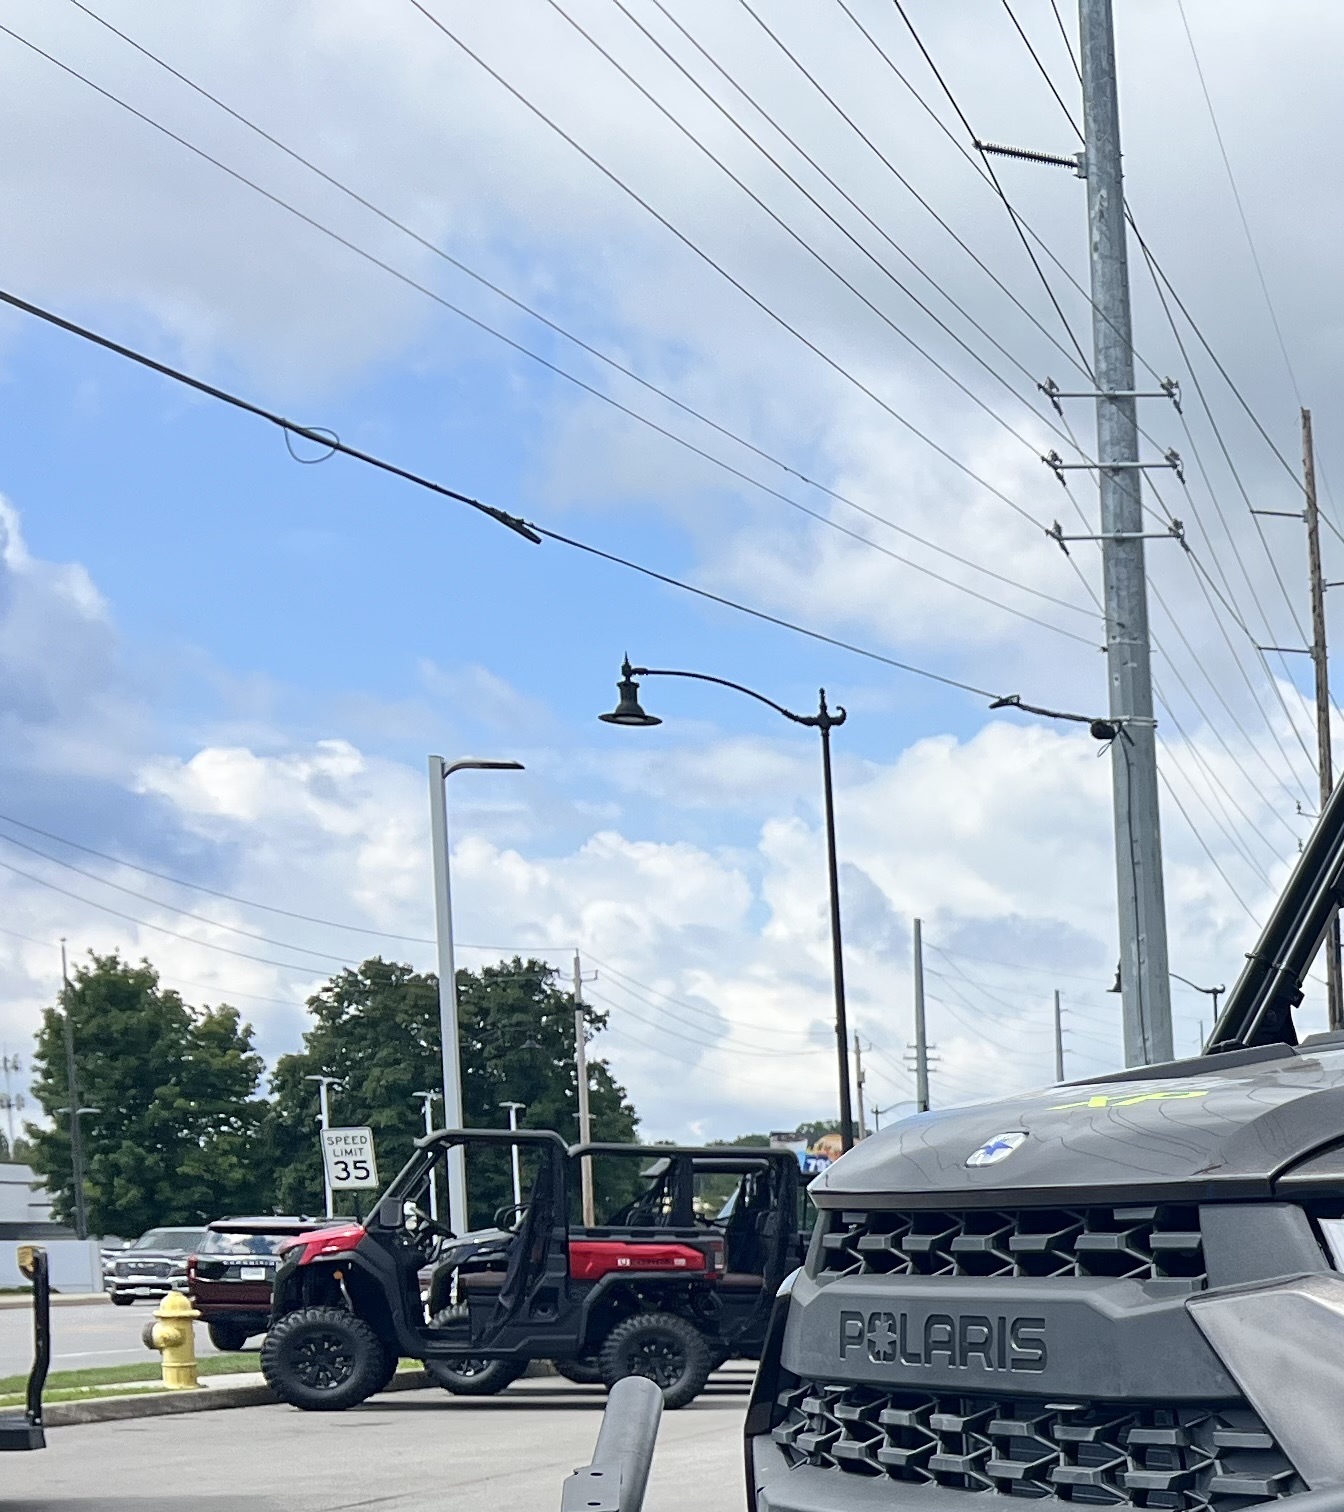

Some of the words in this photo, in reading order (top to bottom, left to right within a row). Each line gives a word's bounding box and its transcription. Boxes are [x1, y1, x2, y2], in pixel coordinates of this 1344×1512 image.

[326, 1135, 368, 1146] SPEED
[332, 1147, 364, 1157] LIMIT
[333, 1160, 370, 1181] 35
[838, 1310, 1049, 1374] POLARIS
